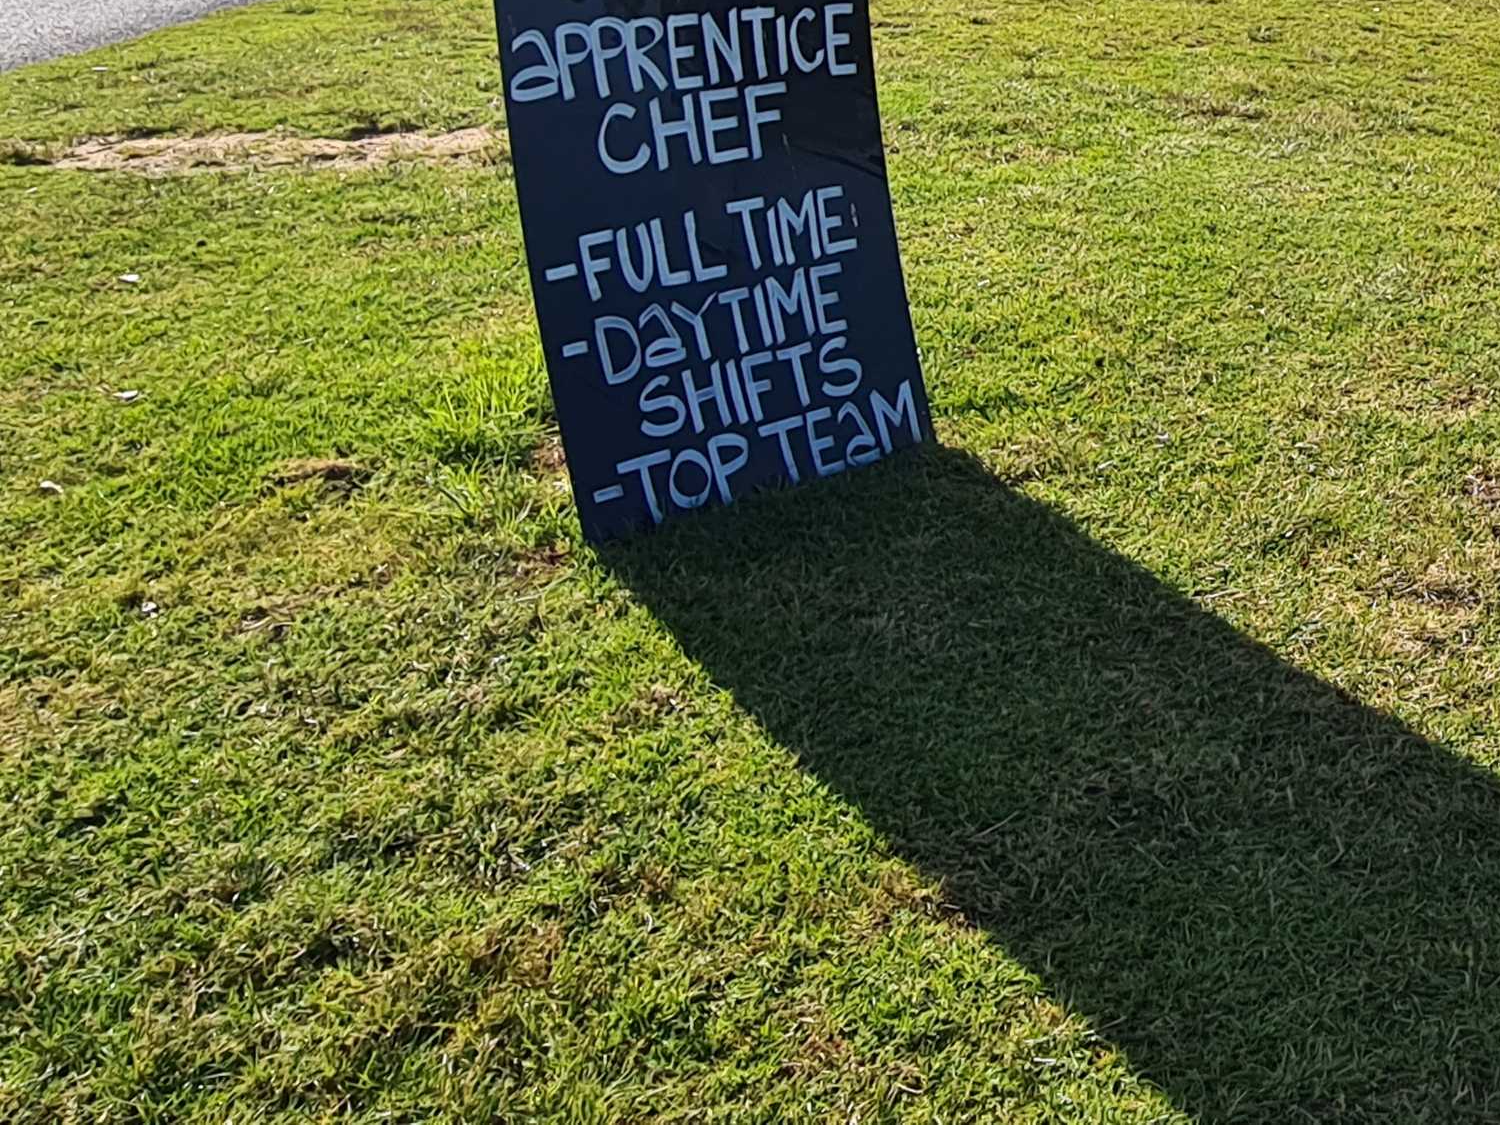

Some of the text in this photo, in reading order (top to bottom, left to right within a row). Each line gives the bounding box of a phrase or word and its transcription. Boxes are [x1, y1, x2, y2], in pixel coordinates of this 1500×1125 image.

[510, 2, 857, 102] aPPRENTICE
[598, 81, 787, 175] CHEF
[726, 185, 857, 270] TIME
[639, 336, 862, 437] SHIFTS
[758, 379, 922, 484] TEaM
